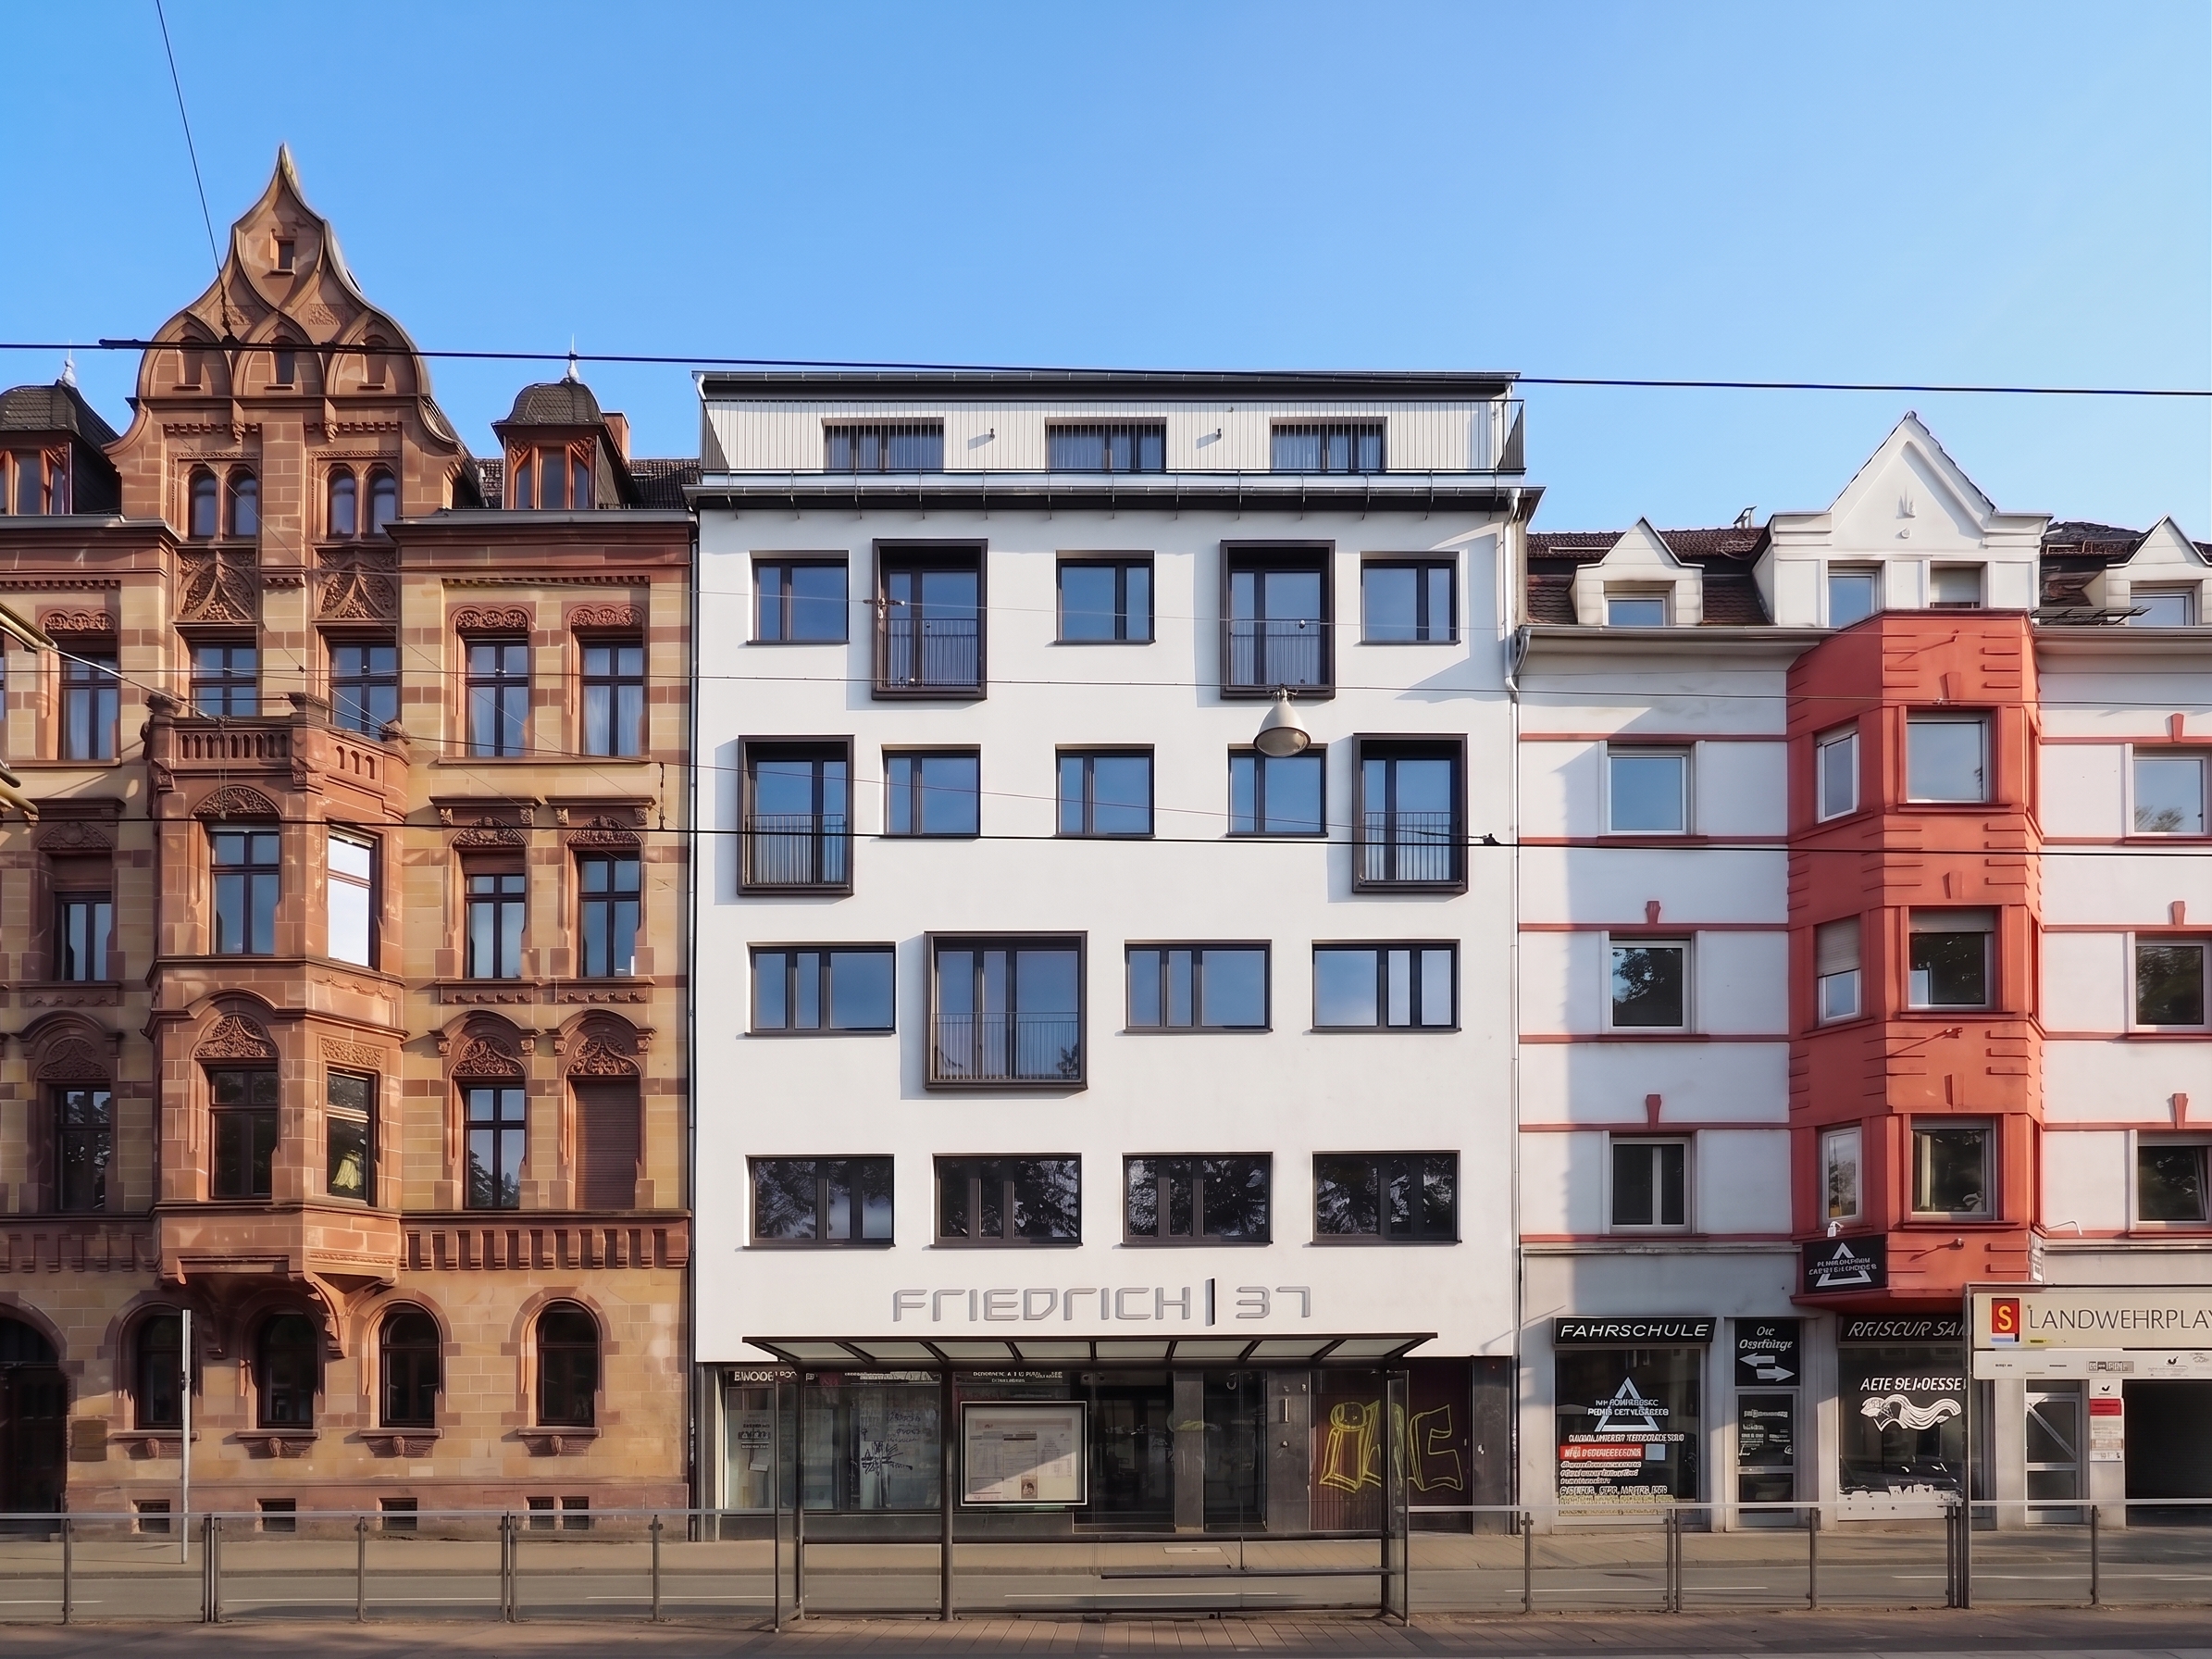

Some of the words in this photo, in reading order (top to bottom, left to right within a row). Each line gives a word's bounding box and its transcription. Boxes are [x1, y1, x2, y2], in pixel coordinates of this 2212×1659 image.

[892, 1287, 1191, 1322] FRIEDRICH
[1236, 1285, 1311, 1319] 37
[1560, 1324, 1709, 1338] FAHRSCHULE
[1997, 1304, 2013, 1331] S
